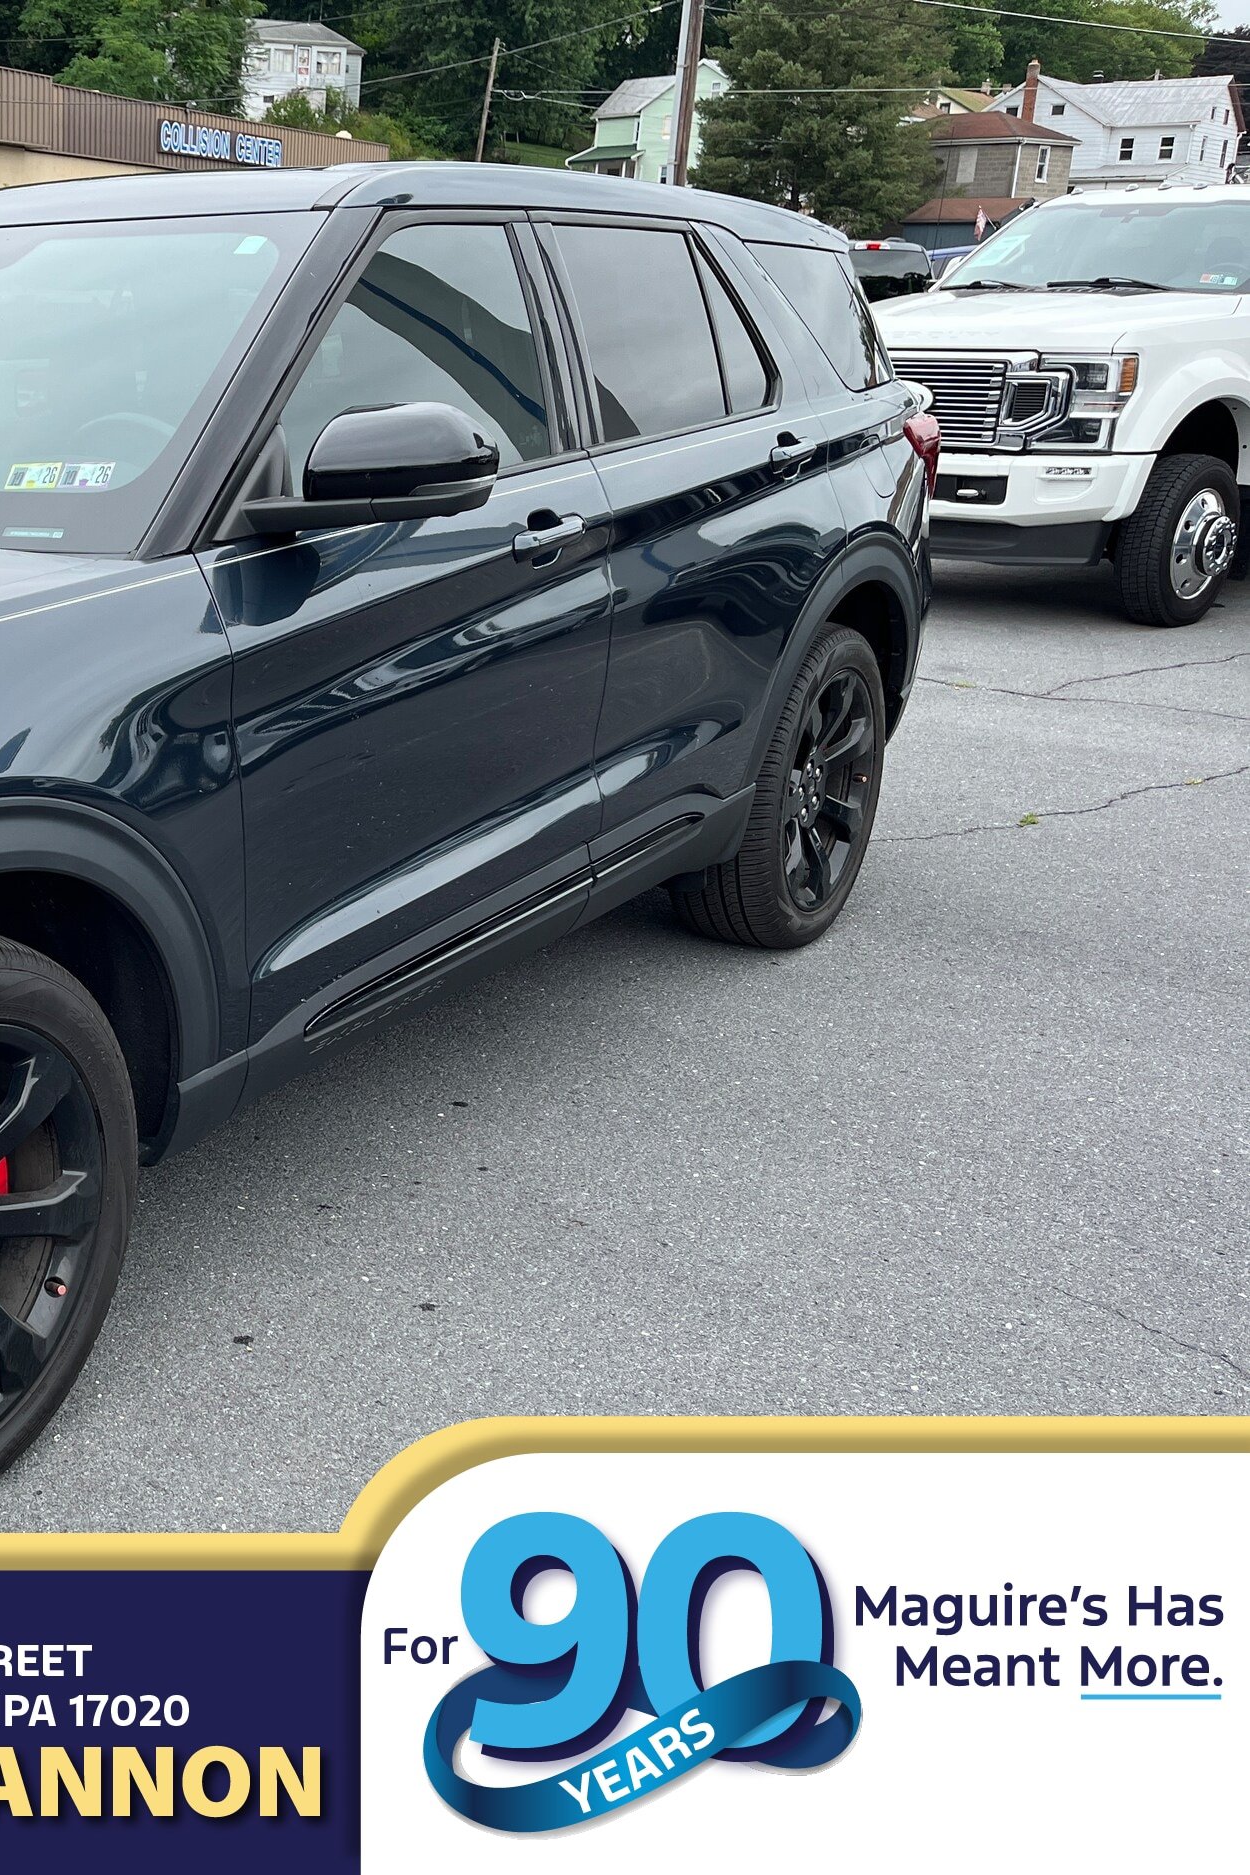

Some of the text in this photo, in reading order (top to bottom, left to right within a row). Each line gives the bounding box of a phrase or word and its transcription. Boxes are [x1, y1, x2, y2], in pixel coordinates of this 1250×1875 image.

[160, 120, 282, 167] COLLISION CENTER
[42, 466, 58, 484] 26
[94, 465, 112, 484] 26
